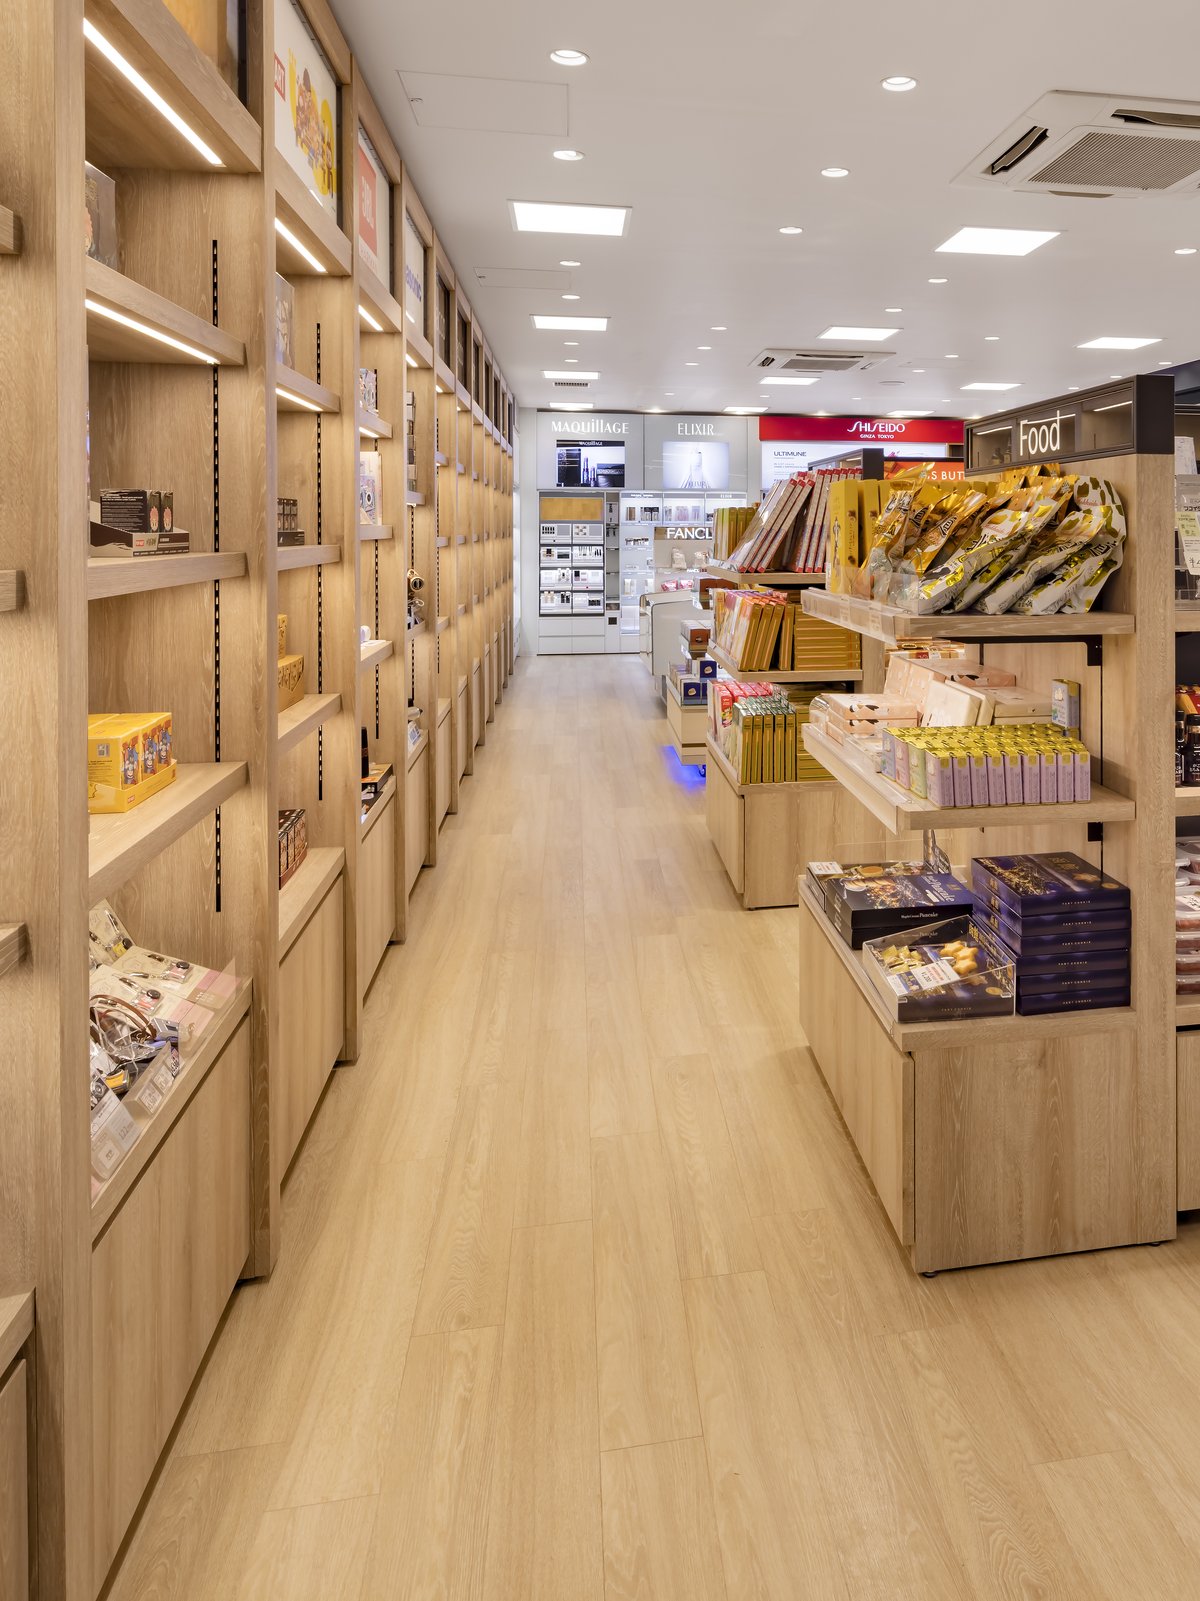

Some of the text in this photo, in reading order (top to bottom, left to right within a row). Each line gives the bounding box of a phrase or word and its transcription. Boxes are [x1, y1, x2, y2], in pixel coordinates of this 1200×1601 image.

[677, 423, 715, 435] ELIXIR
[847, 421, 906, 433] SHISEIDO
[1020, 411, 1061, 455] Food
[667, 528, 712, 539] FANCL
